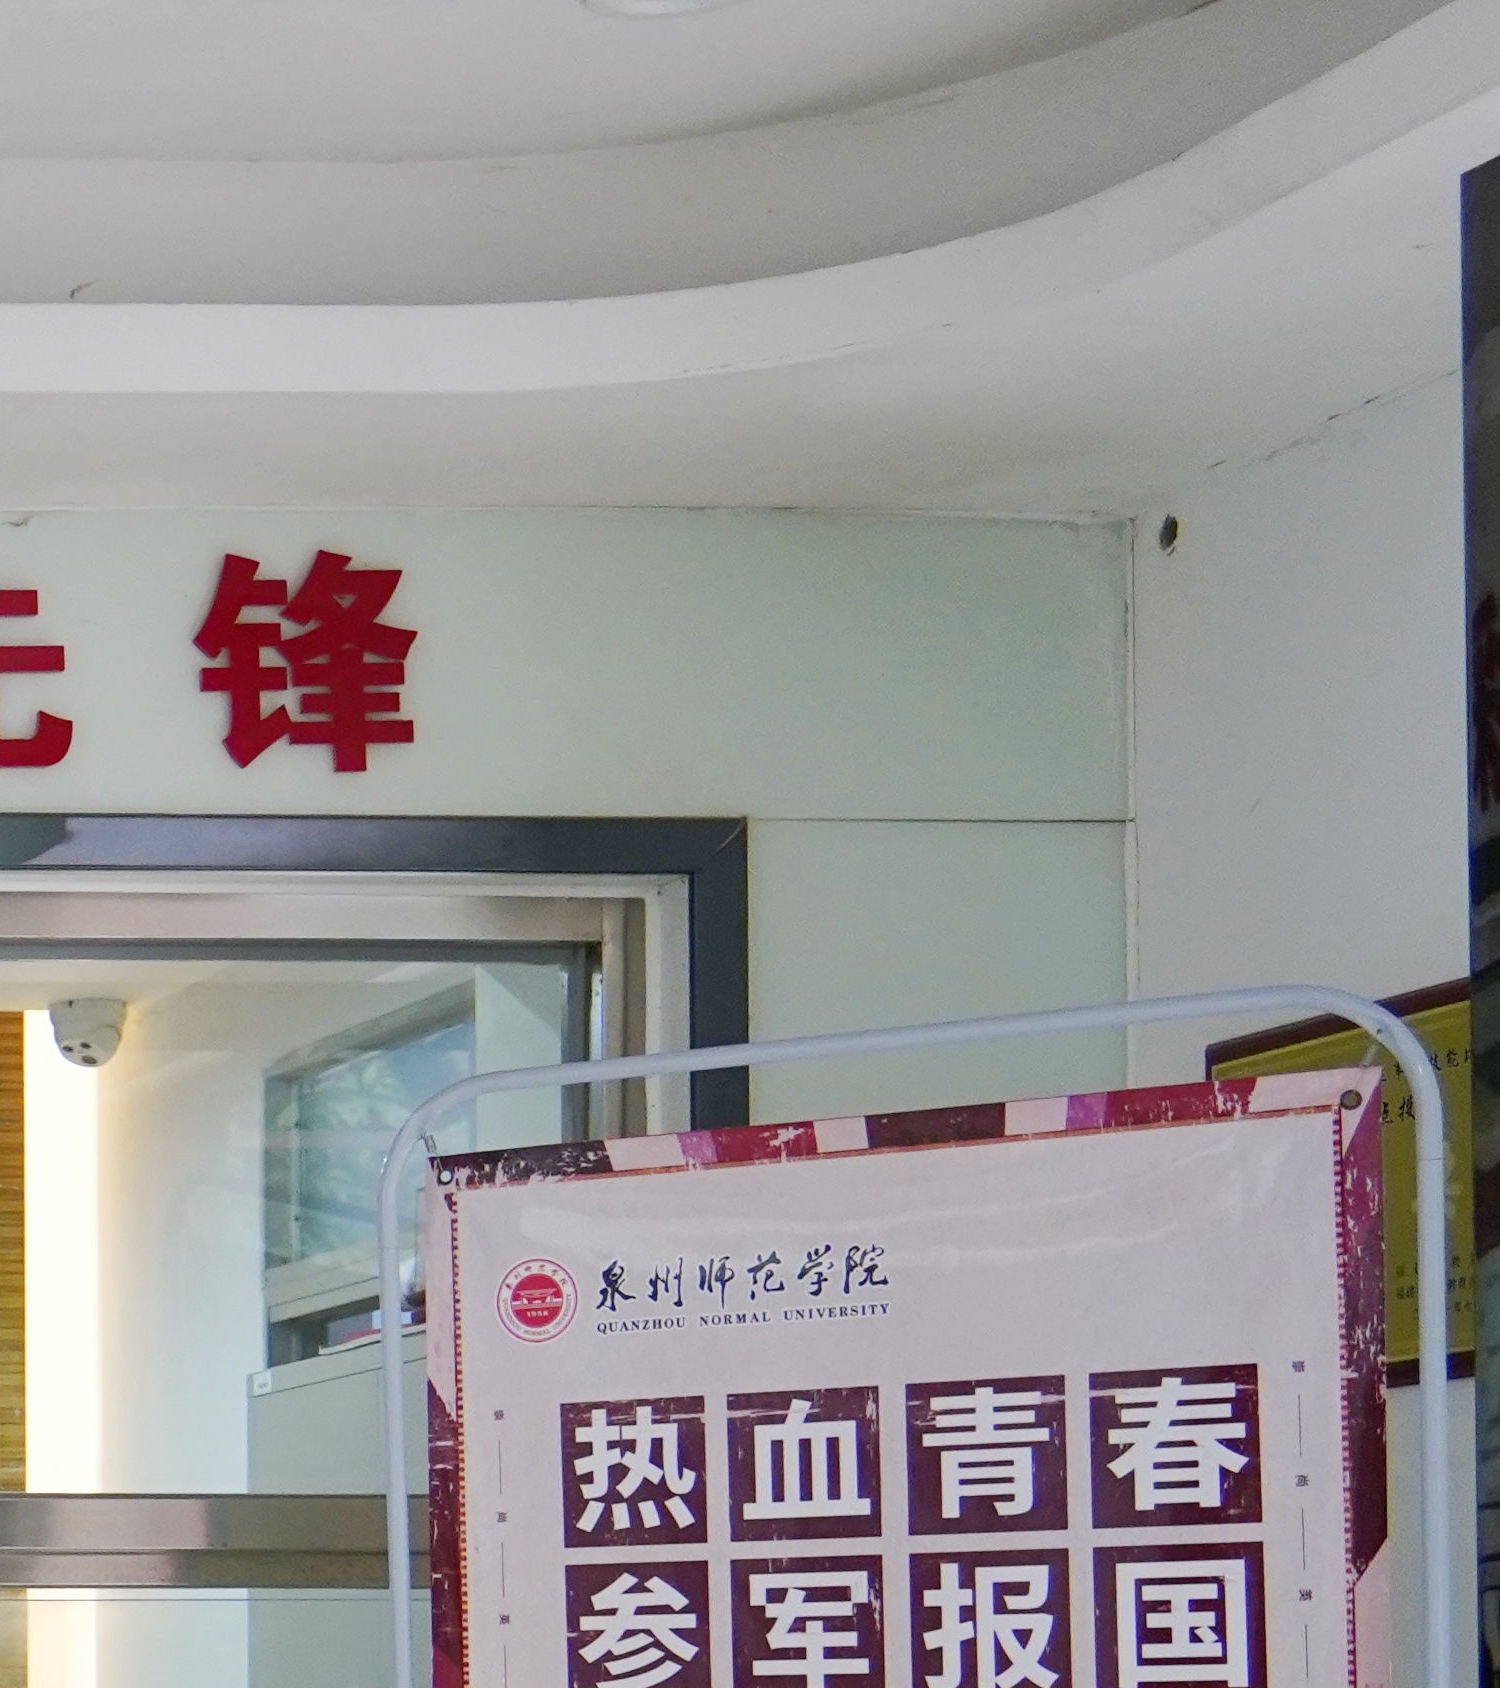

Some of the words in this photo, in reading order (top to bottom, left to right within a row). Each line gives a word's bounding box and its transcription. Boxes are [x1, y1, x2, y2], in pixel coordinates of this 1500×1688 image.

[596, 1243, 889, 1313] 泉州师范学院
[596, 1316, 687, 1335] QUANZHOU
[699, 1310, 772, 1328] NORMAL
[783, 1302, 890, 1322] UNIVERSITY
[572, 1376, 1250, 1534] 热血青春
